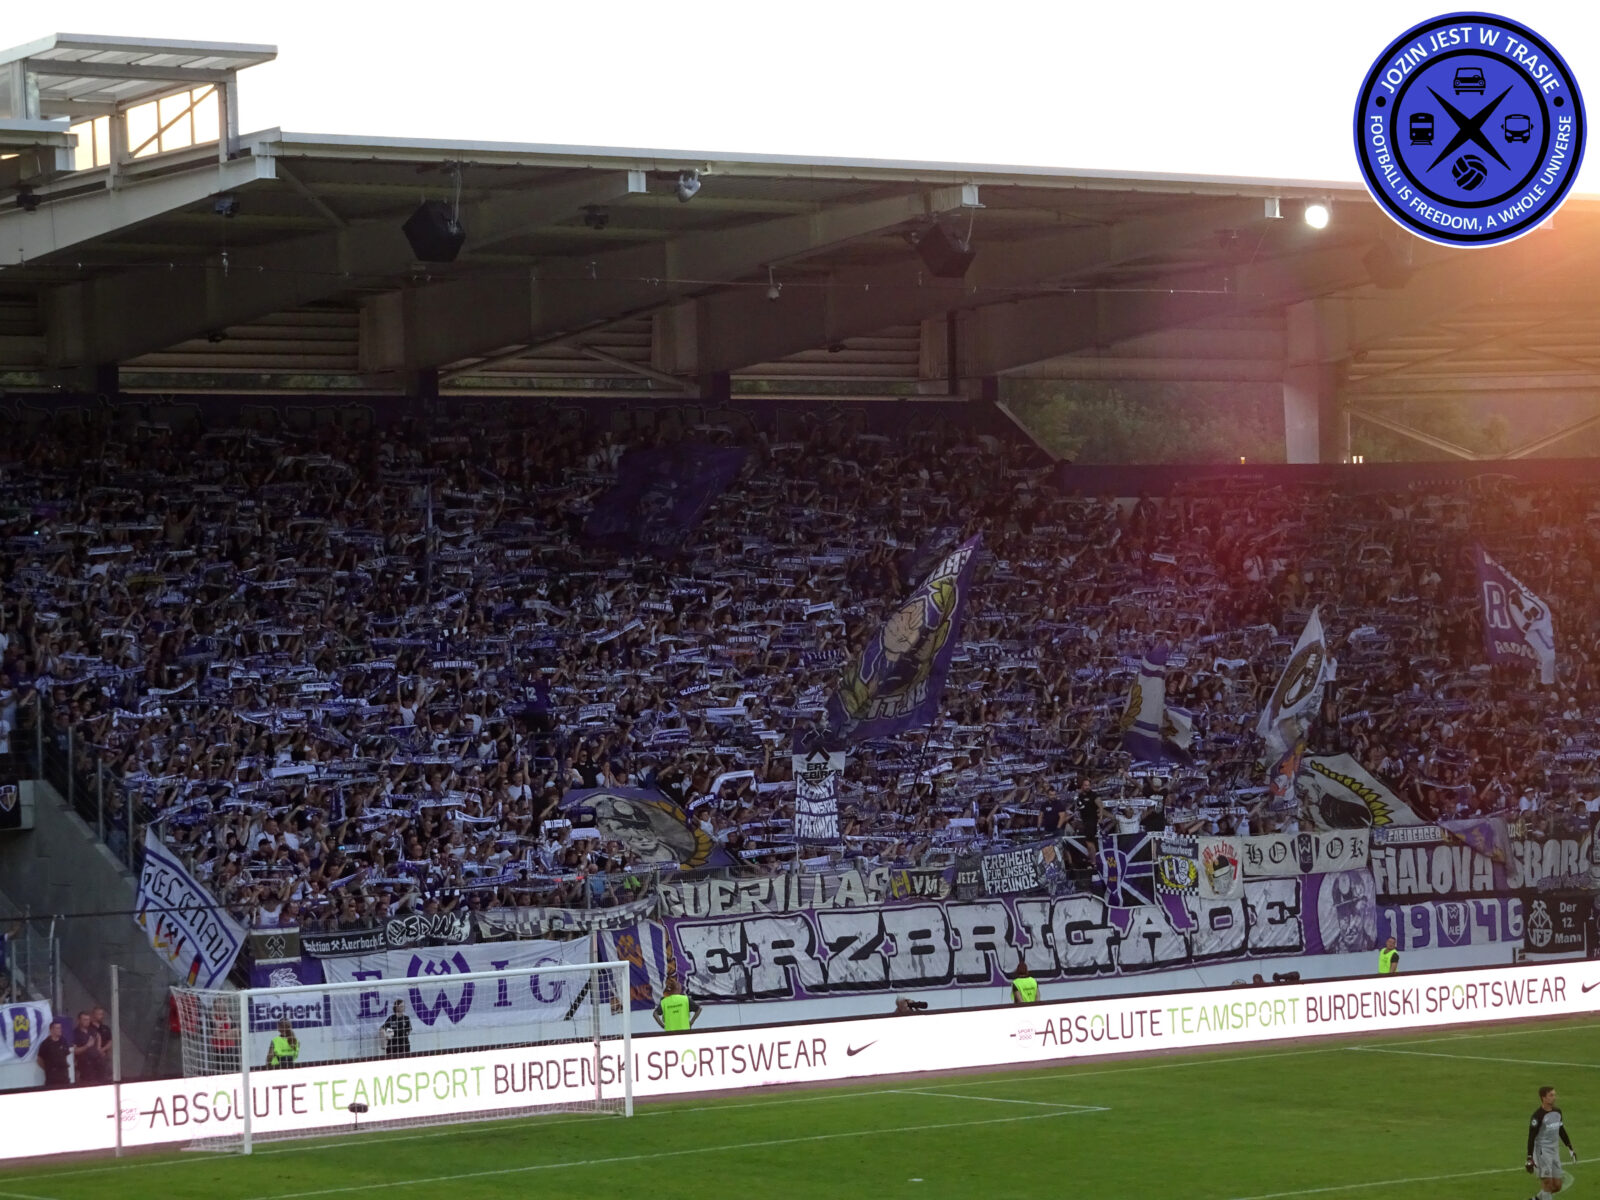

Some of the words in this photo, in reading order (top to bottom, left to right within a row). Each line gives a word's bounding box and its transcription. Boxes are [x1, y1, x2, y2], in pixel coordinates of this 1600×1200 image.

[984, 849, 1034, 869] FREIHEIT
[986, 873, 1039, 894] FREUNDE
[1559, 902, 1577, 912] Der
[1562, 917, 1576, 928] 12.
[676, 877, 1302, 1000] ERZBRIGADE
[1554, 933, 1582, 944] Mann
[255, 1001, 322, 1021] Eichert
[1036, 1009, 1163, 1046] ABSOLUTE
[1167, 998, 1300, 1034] TEAMSPORT
[1306, 987, 1420, 1023] BURDENSKI
[1426, 976, 1567, 1014] SPORTSWEAR
[141, 1083, 307, 1128] ABSOLUTE
[314, 1065, 486, 1112] TEAMSPORT
[494, 1052, 639, 1095] BURDENSKI
[647, 1037, 827, 1081] SPORTSWEAR
